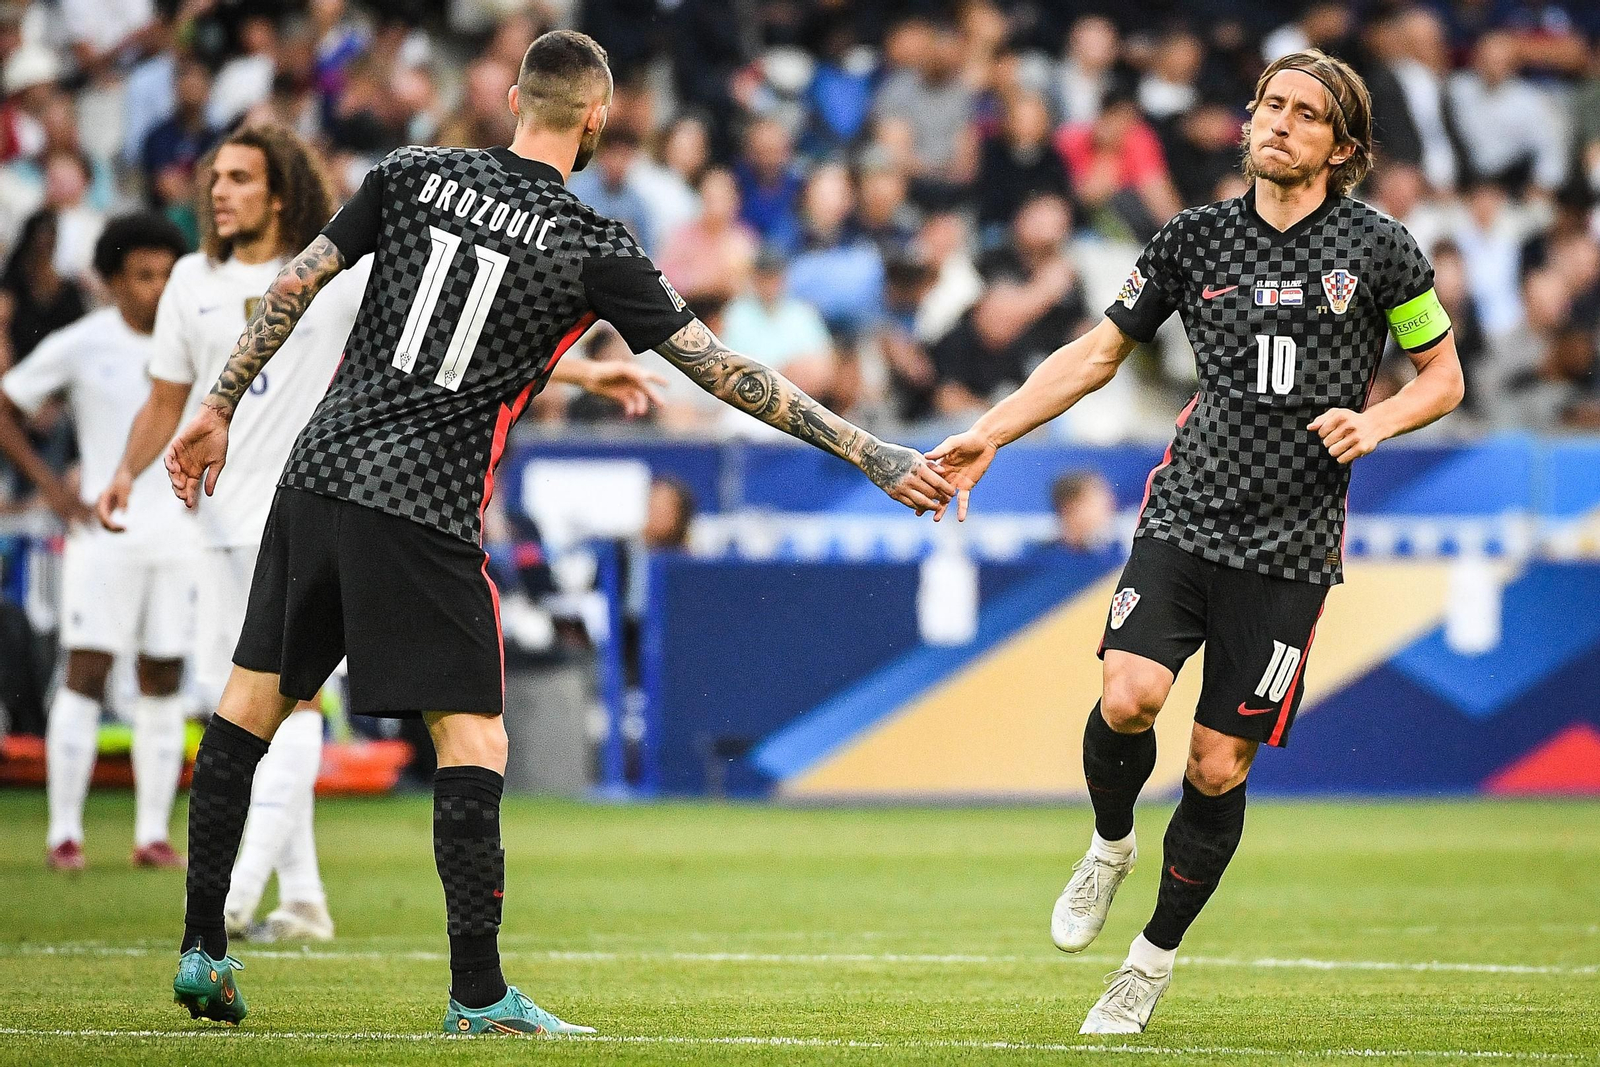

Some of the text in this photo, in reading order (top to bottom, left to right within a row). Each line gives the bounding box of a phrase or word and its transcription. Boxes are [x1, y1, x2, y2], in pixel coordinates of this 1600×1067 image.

[418, 173, 557, 251] BROZOVIĆ
[391, 225, 510, 392] 11
[1393, 312, 1429, 334] RESPECT
[1255, 334, 1297, 394] 10
[1254, 640, 1301, 703] 10
